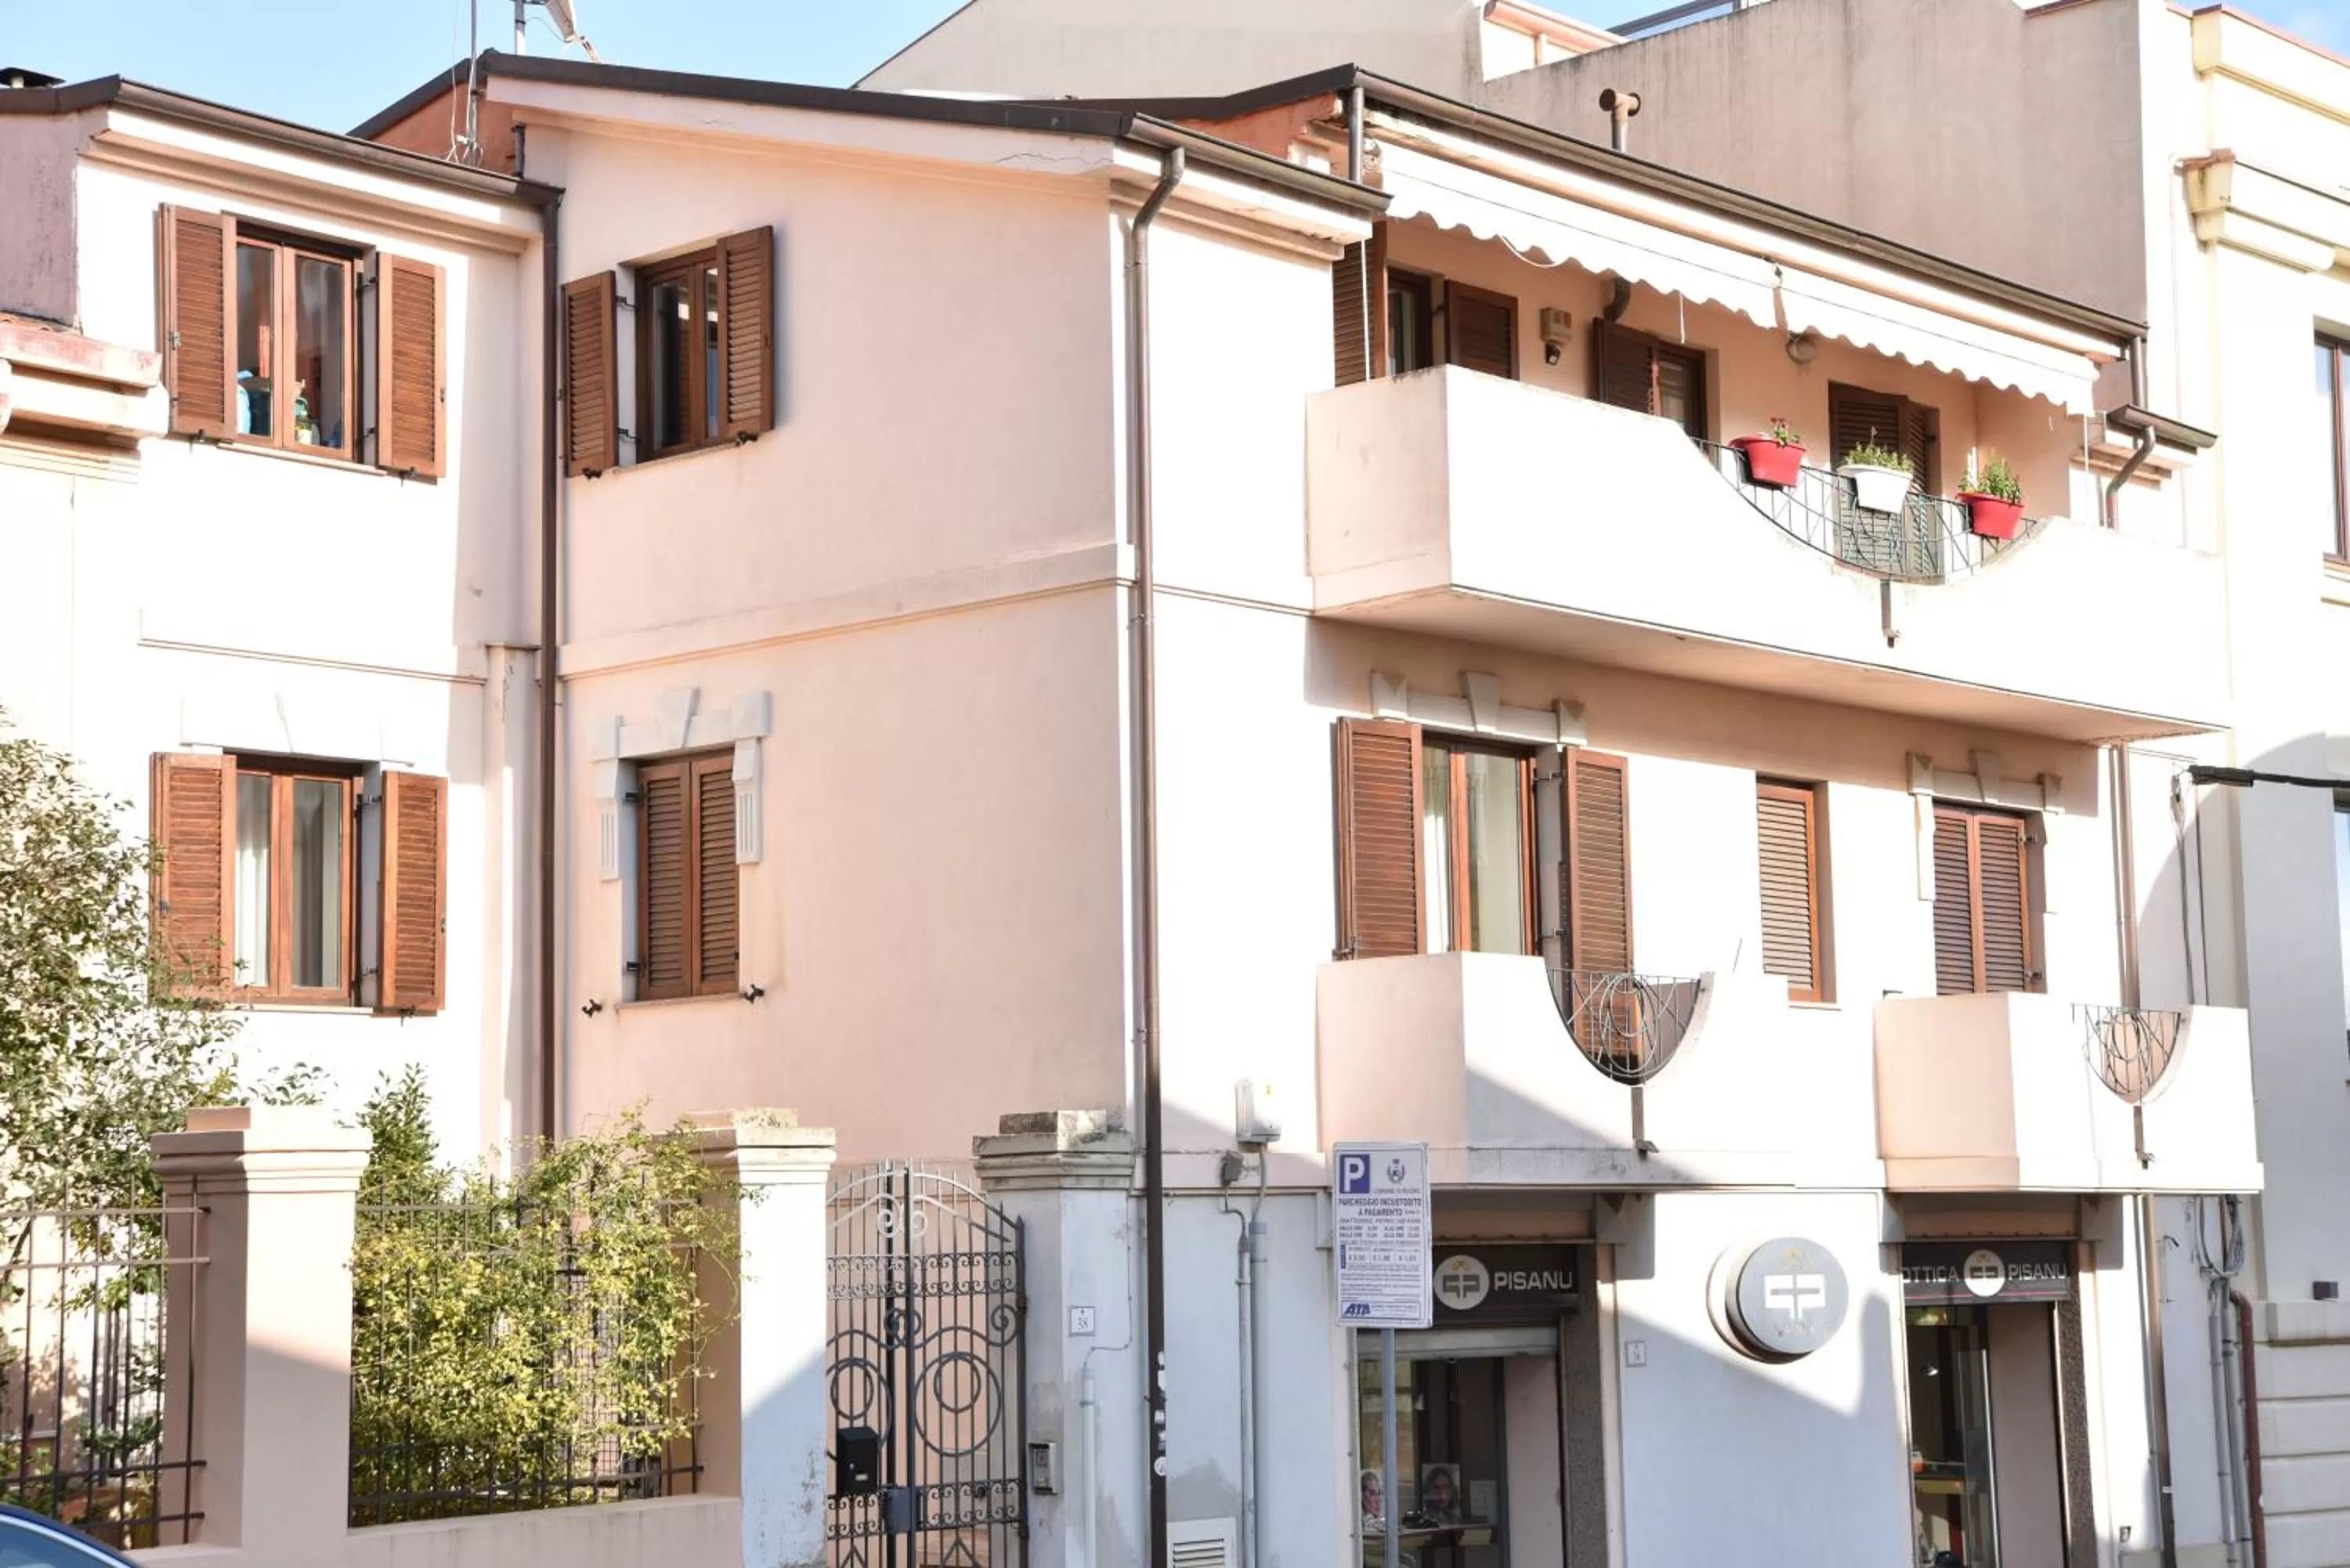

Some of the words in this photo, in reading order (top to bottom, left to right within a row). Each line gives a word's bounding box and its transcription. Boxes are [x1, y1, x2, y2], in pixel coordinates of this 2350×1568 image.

[1343, 1157, 1365, 1193] P
[1338, 1198, 1379, 1207] PARCHEGGIO
[1380, 1198, 1422, 1207] INCUSTODITO
[1358, 1208, 1364, 1216] A
[1364, 1208, 1403, 1216] PAGAMENTO
[1494, 1270, 1573, 1291] PISANU
[2008, 1263, 2068, 1281] PISANU
